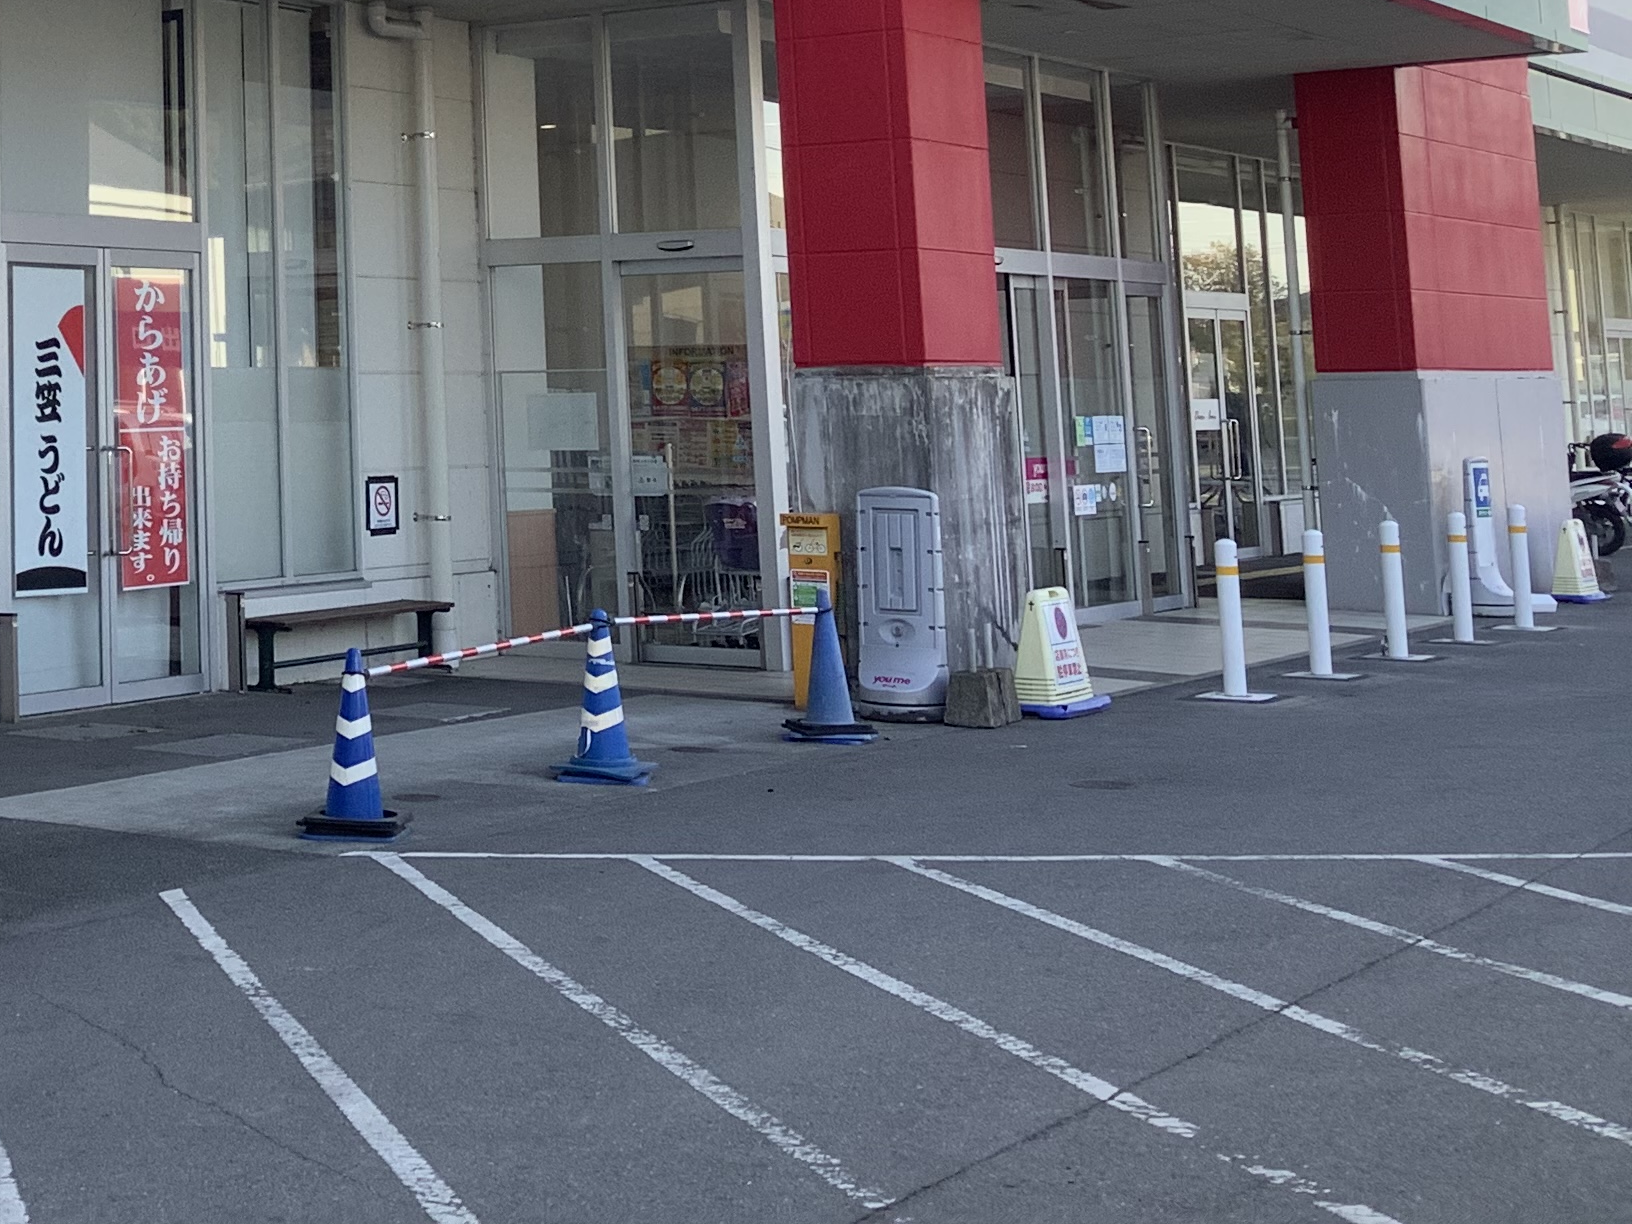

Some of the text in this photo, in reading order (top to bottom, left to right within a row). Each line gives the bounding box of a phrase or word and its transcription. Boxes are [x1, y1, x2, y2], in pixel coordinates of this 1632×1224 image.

[134, 280, 167, 426] からあげ
[34, 336, 65, 558] 三笠うどん
[157, 435, 185, 575] お持ち帰り
